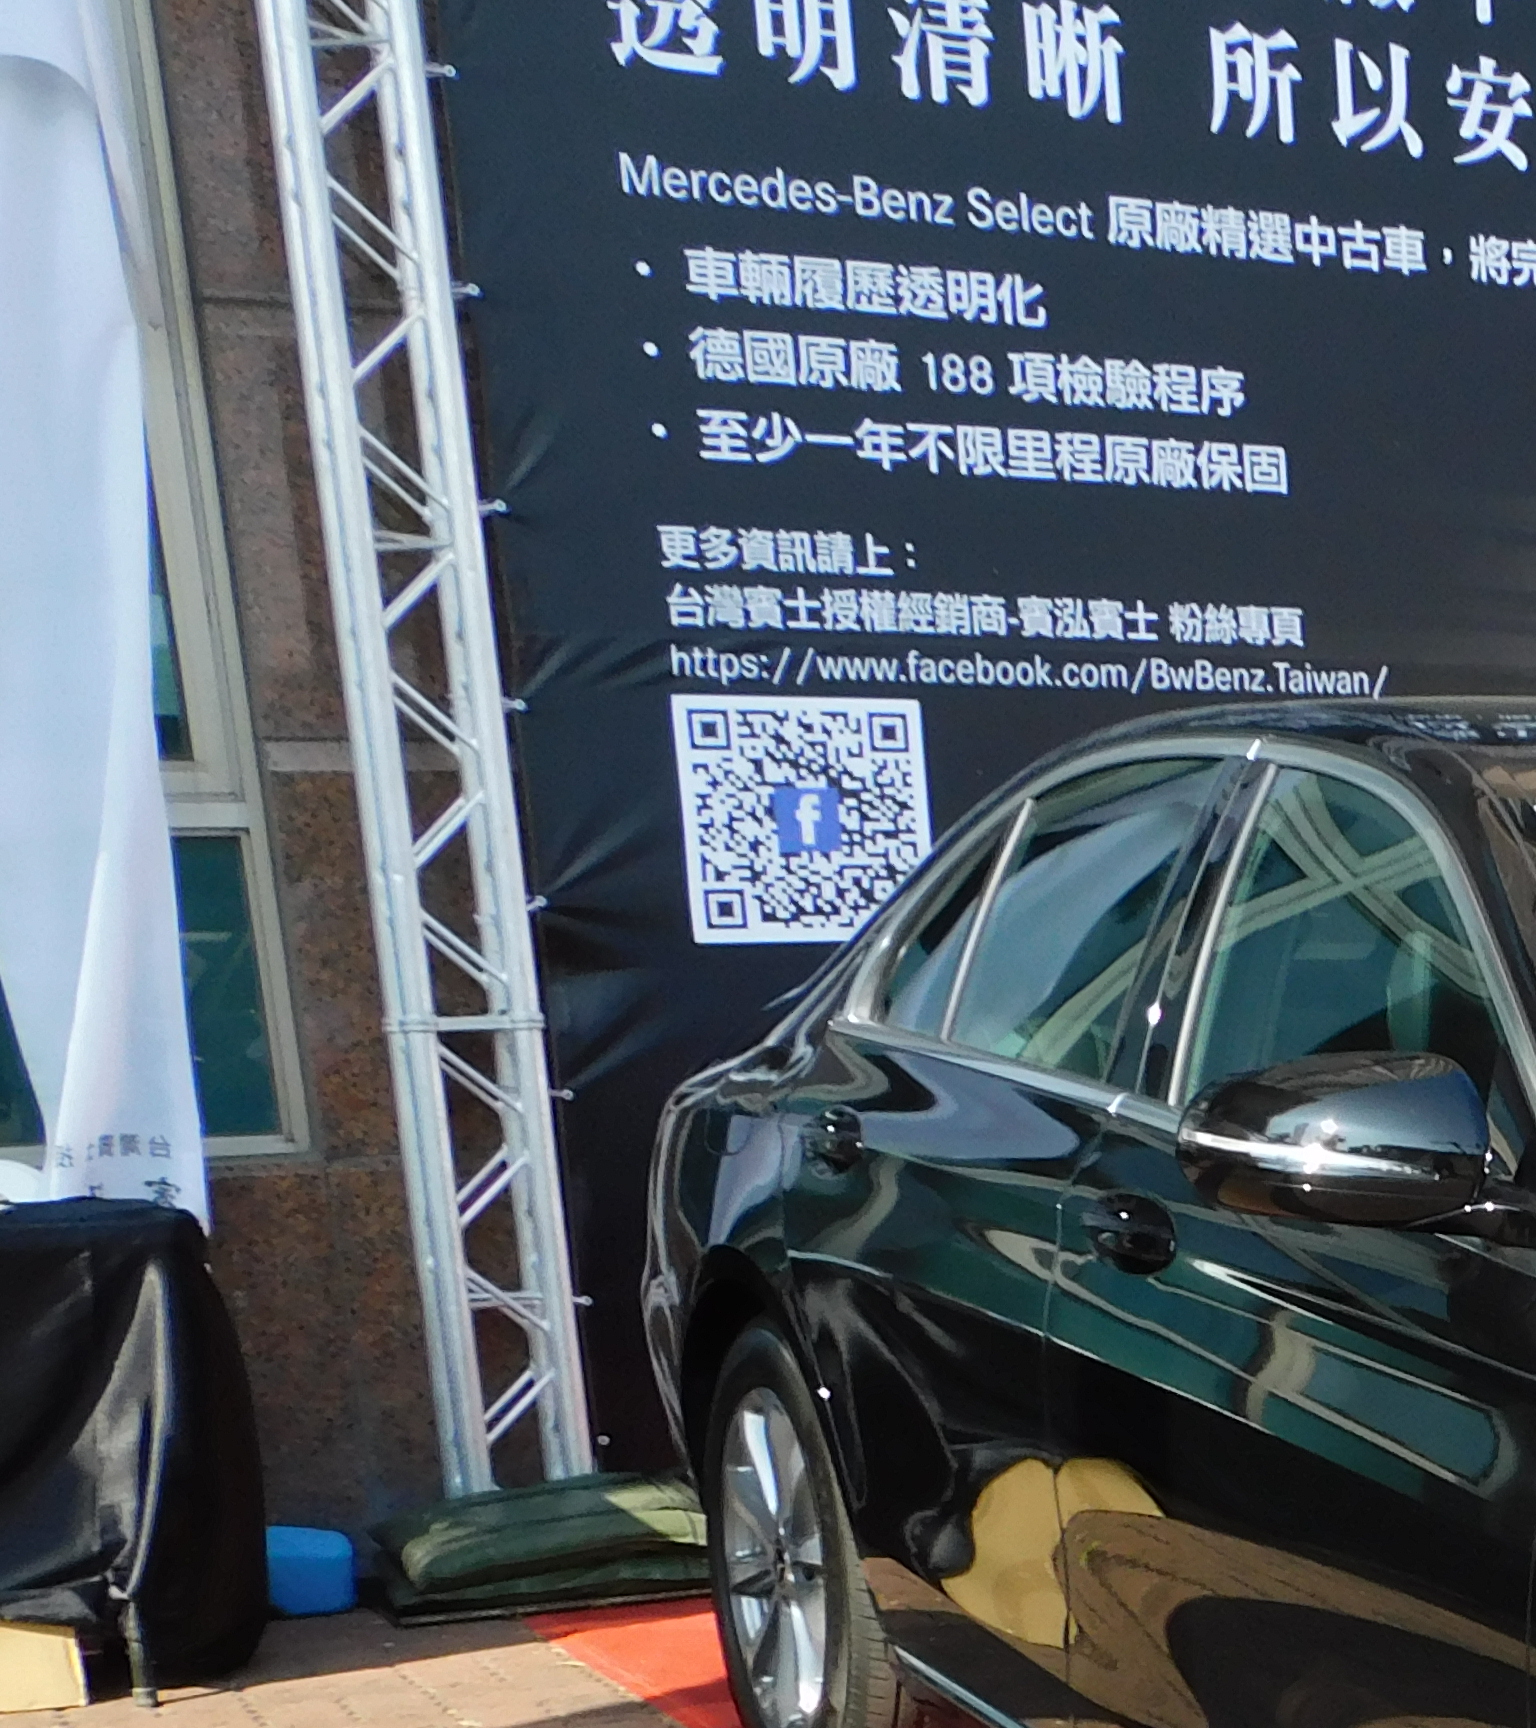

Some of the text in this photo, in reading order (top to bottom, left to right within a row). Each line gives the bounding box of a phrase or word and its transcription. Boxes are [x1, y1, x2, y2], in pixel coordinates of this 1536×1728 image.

[609, 0, 1125, 124] 透明清晰
[617, 151, 955, 228] Mercedes-Benz
[967, 186, 1095, 240] Select
[683, 246, 1049, 328] 車輛履歷透明化
[688, 326, 1247, 418] 德國原廠 188 項檢驗程序
[696, 408, 1290, 496] 至少一年不限里程原廠保固
[1168, 601, 1305, 647] 粉絲專頁
[670, 643, 1389, 700] https://www.facebook.com/BwBenz.Taiwan/
